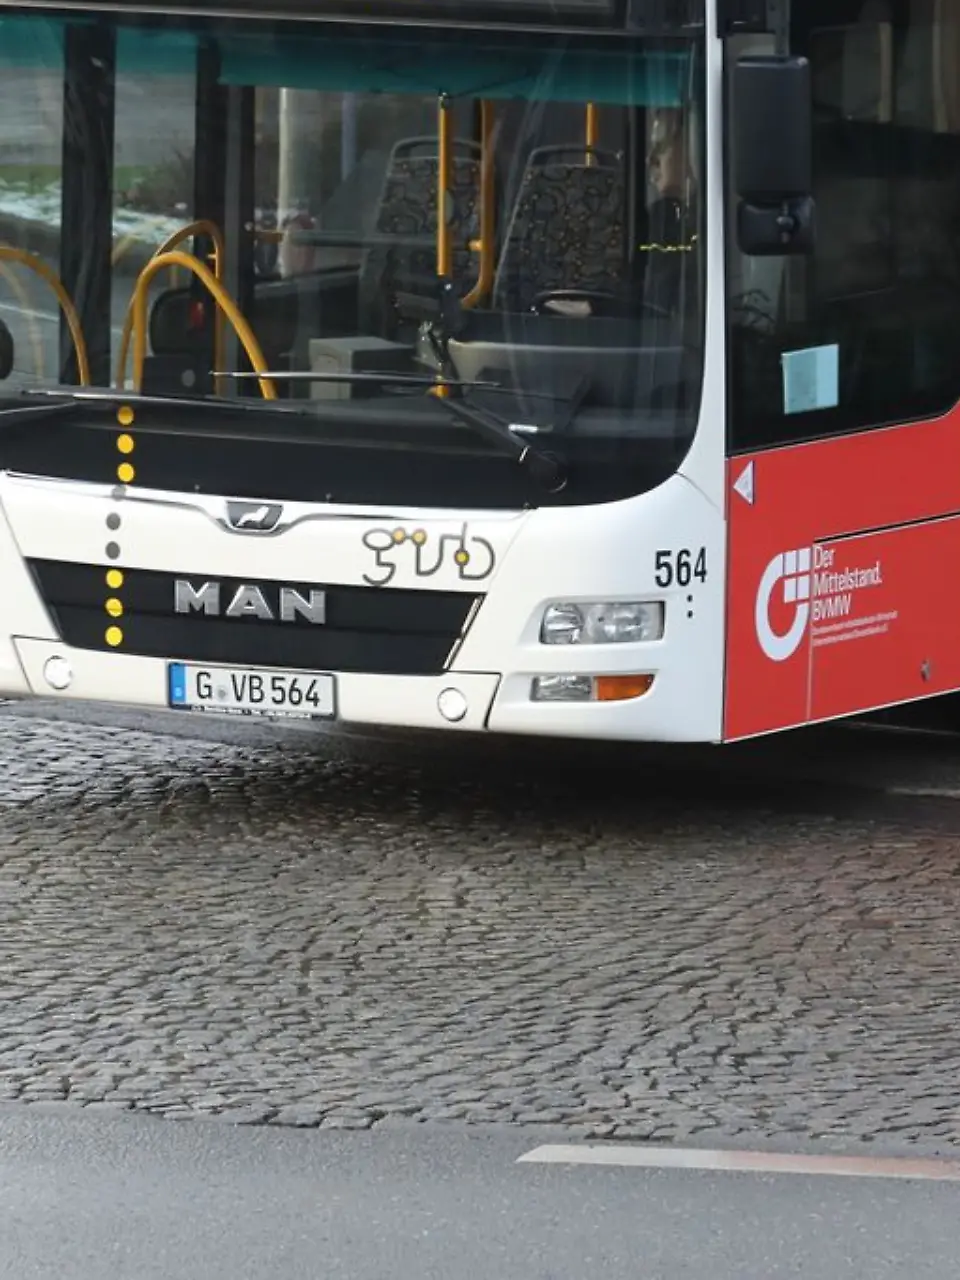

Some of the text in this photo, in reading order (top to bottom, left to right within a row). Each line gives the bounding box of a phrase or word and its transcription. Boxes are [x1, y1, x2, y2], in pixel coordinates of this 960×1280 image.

[654, 545, 708, 588] 564
[813, 545, 835, 569] Der
[812, 560, 882, 596] Mittelstand.
[173, 579, 327, 625] MAN
[812, 592, 851, 621] BVMW
[196, 671, 322, 709] G VB 564
